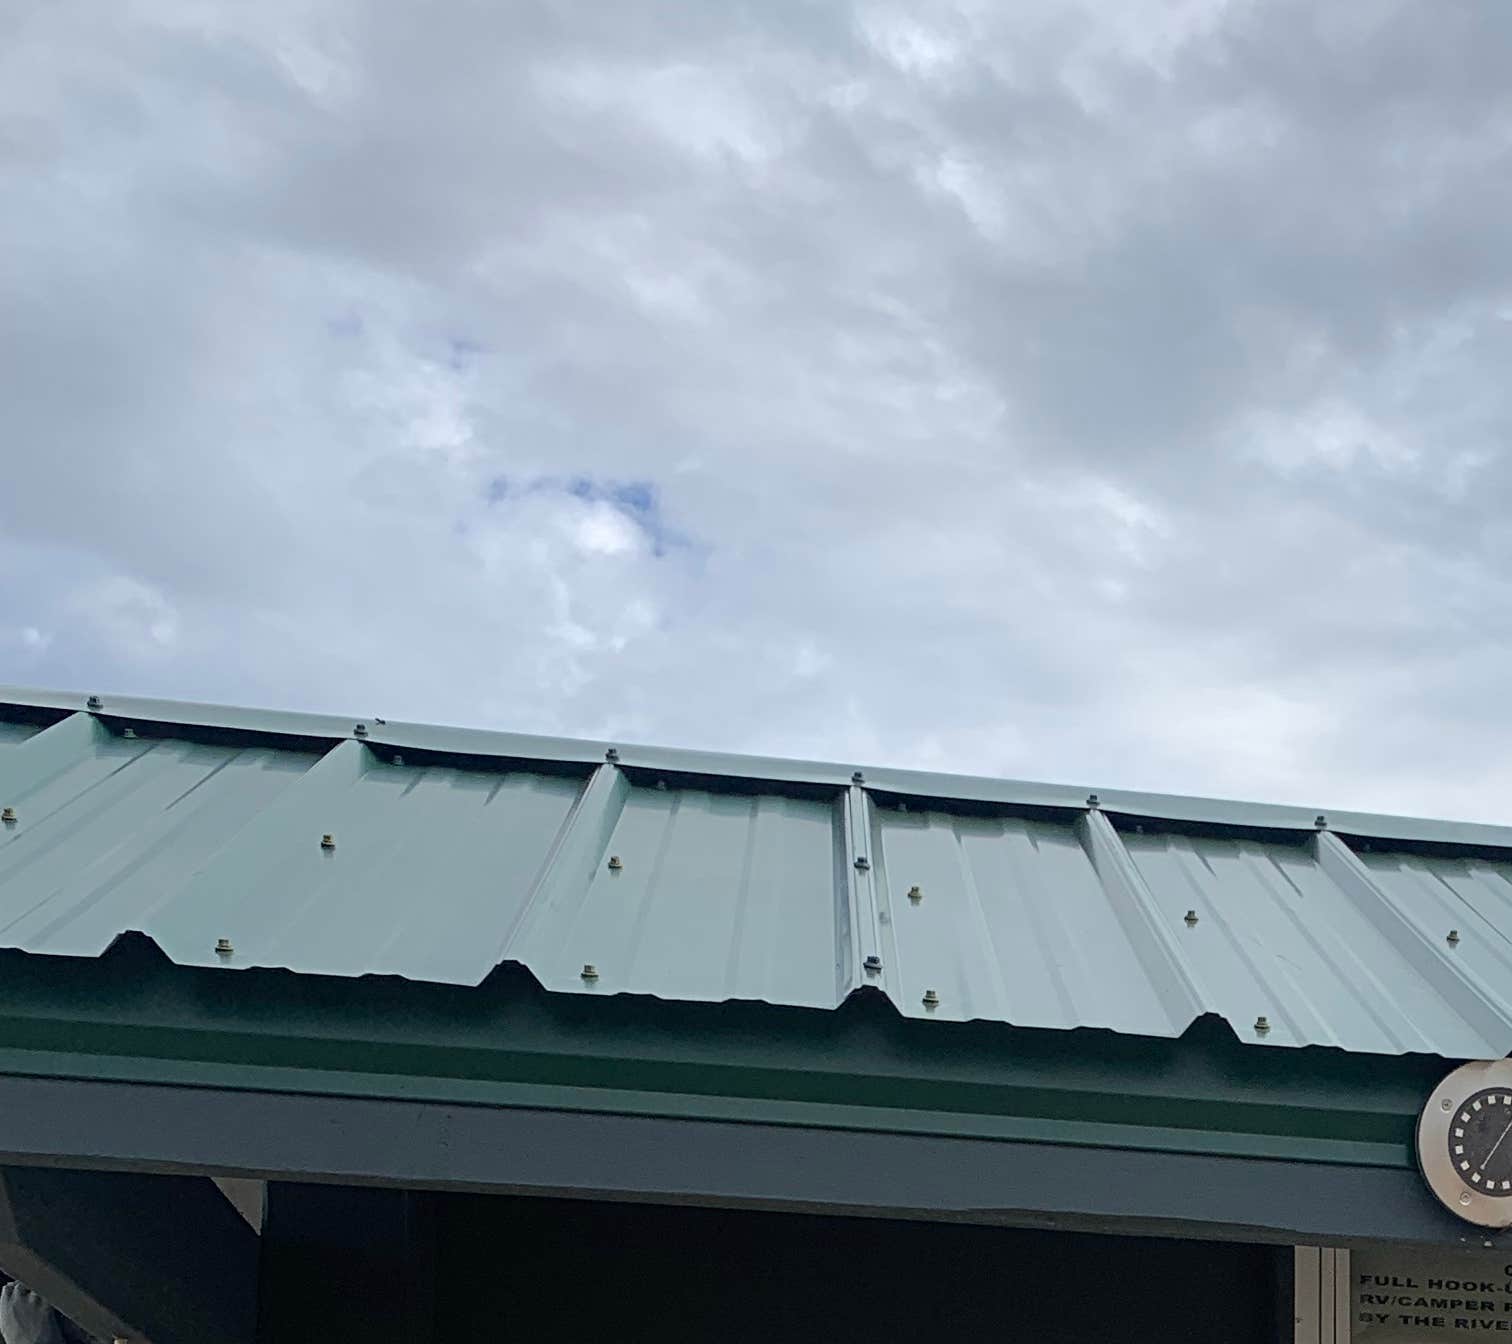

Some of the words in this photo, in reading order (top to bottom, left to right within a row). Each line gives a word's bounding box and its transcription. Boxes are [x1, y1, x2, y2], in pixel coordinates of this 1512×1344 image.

[1359, 1274, 1419, 1289] FULL
[1359, 1294, 1496, 1312] RV/CAMPER
[1358, 1313, 1390, 1324] BY
[1398, 1315, 1445, 1328] THE
